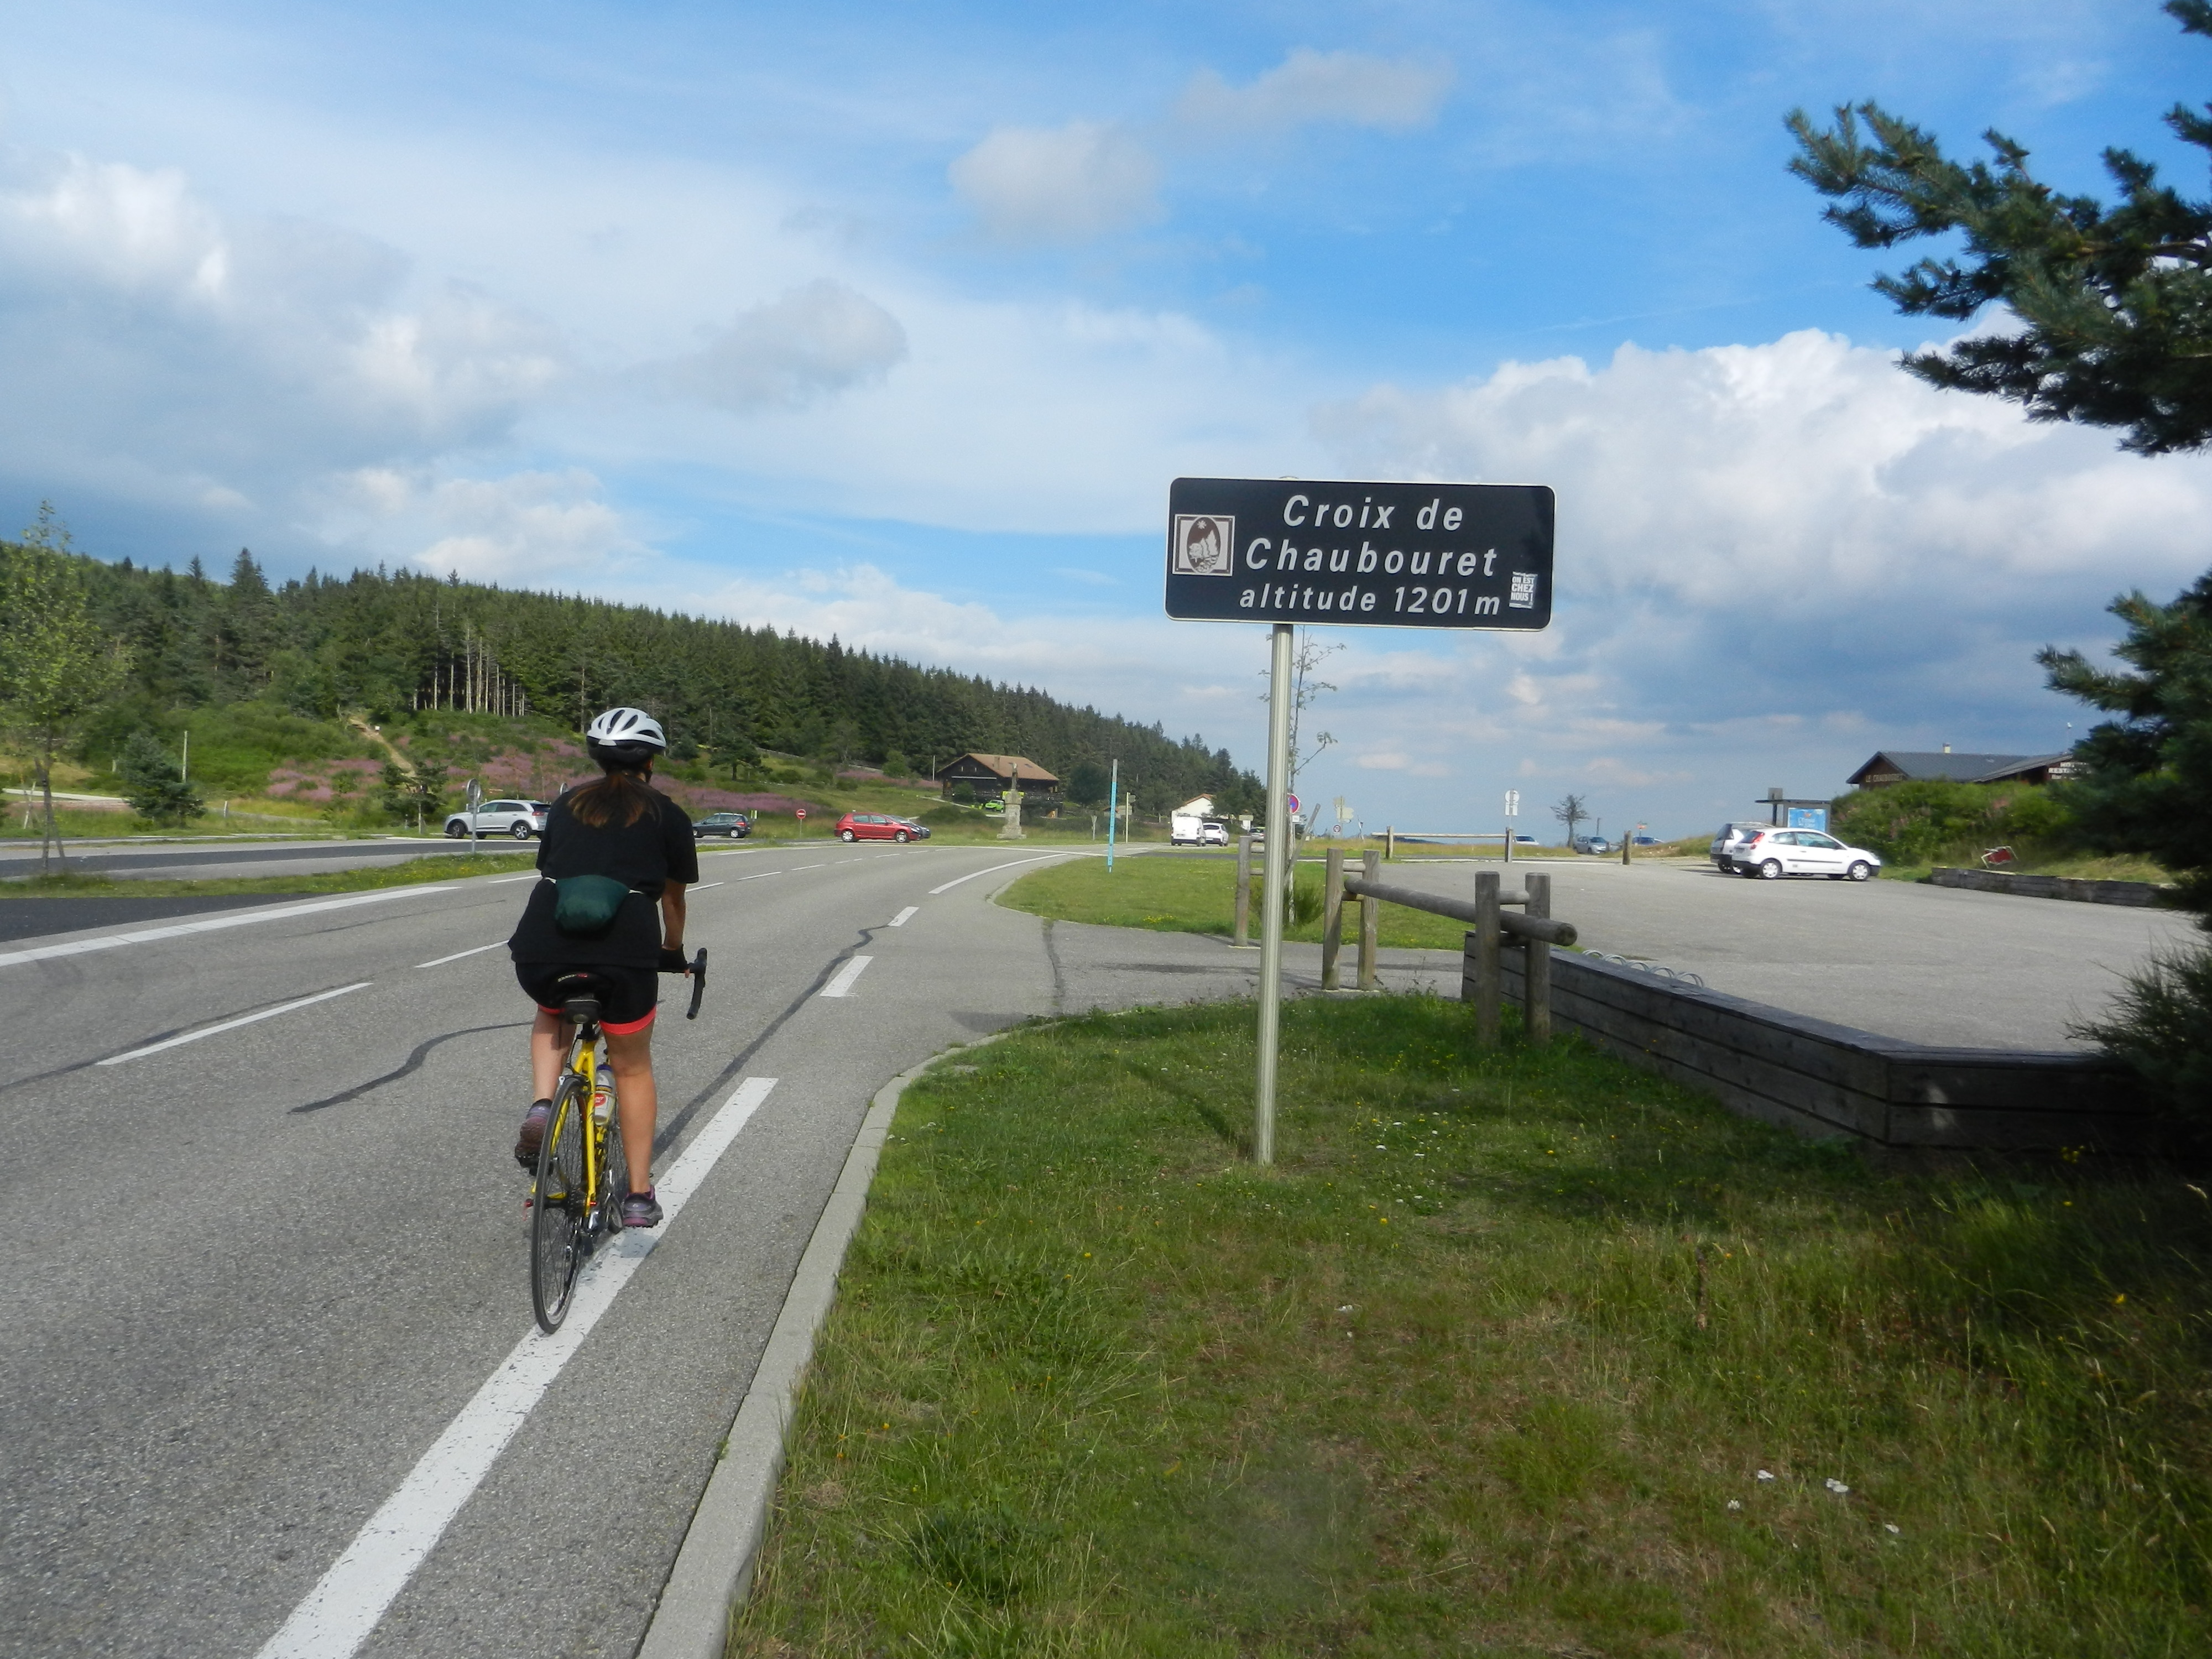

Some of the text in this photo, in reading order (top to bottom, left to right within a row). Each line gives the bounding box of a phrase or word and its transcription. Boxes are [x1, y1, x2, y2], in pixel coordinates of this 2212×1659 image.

[1283, 494, 1463, 531] Croix de
[1245, 537, 1498, 577] Chaubouret
[1239, 582, 1501, 615] altitude 1201m
[1510, 592, 1529, 601] NOUS
[1511, 583, 1534, 592] CHEZ
